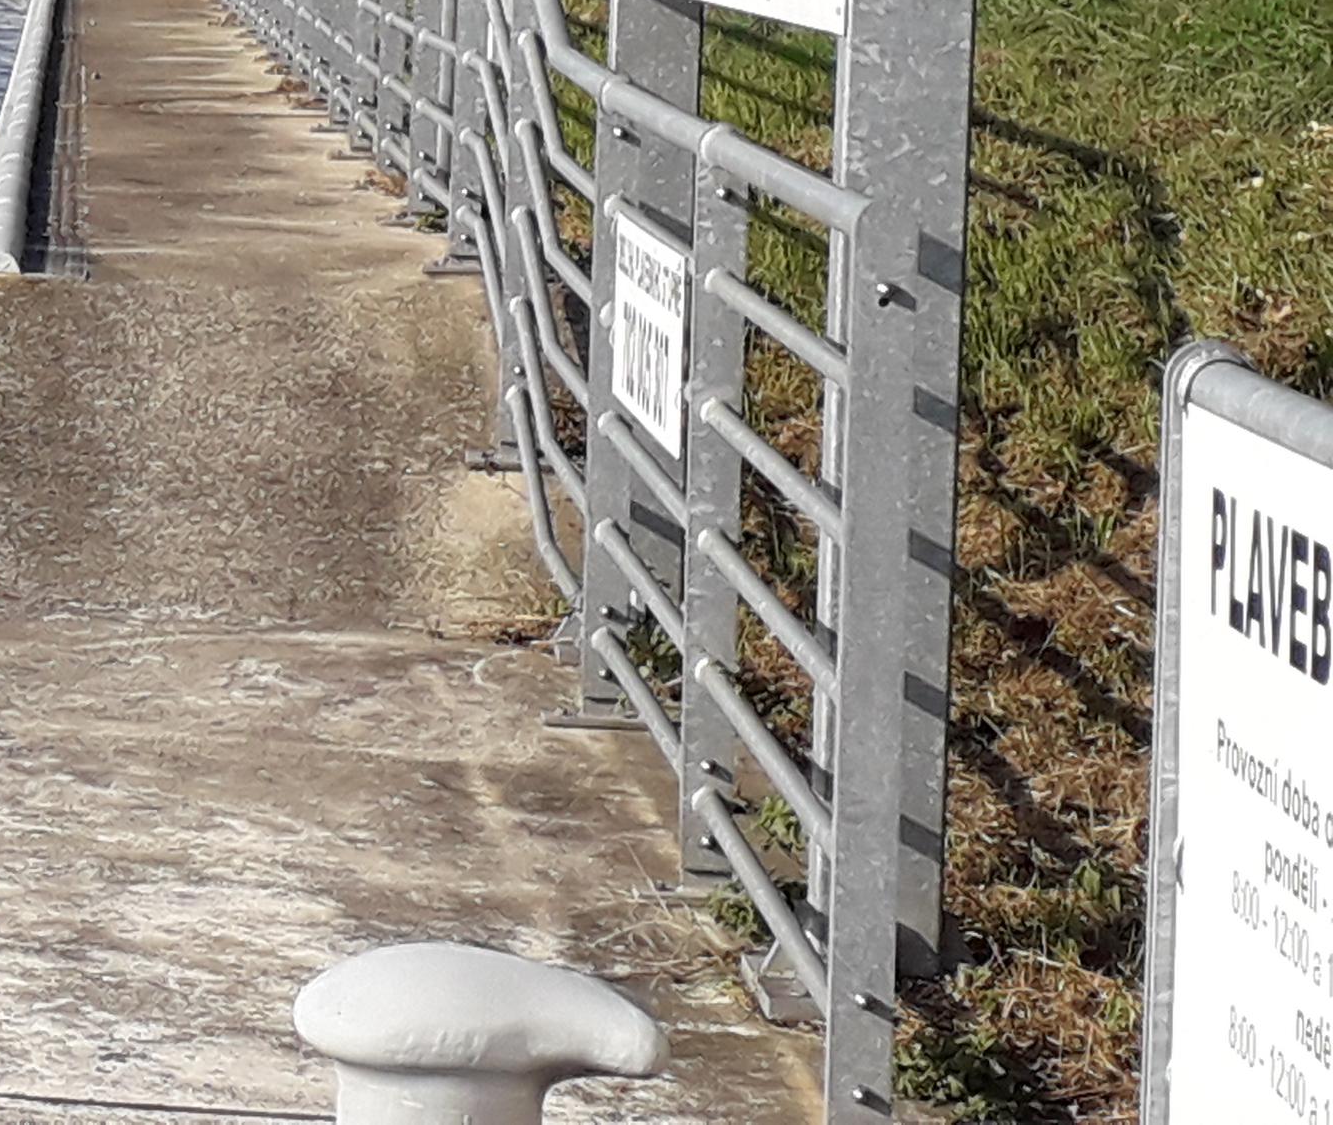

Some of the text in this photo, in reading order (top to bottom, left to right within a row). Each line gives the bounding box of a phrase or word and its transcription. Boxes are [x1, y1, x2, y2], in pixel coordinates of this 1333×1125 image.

[1210, 486, 1332, 686] PLAVEB
[1216, 717, 1279, 807] Provozní
[1282, 768, 1320, 839] doba
[1264, 840, 1318, 913] pondělí
